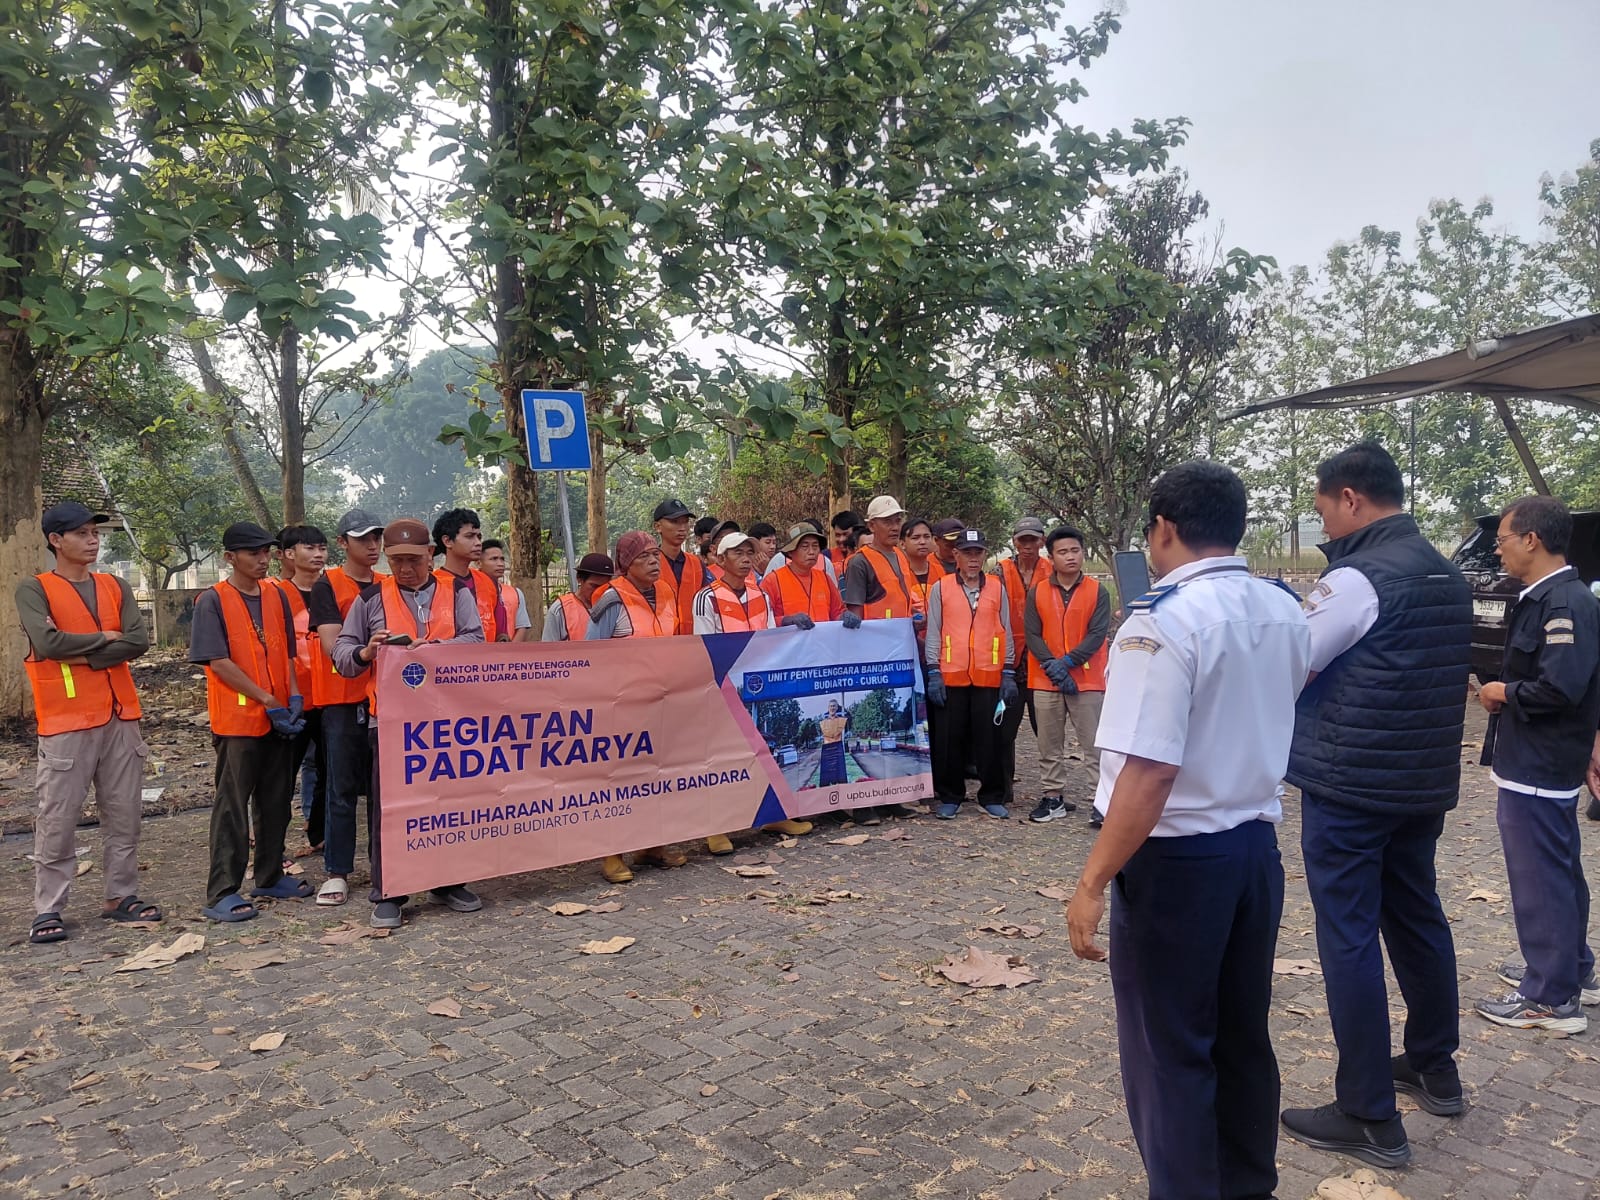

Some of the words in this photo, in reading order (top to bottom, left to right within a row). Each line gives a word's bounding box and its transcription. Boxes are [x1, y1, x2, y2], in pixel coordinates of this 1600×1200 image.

[533, 399, 576, 463] P
[434, 673, 480, 685] BANDAR
[482, 672, 519, 683] UDARA
[520, 669, 571, 681] BUDIARTO
[435, 664, 479, 675] KANTOR
[481, 663, 506, 673] UNIT
[508, 659, 591, 672] PENYELENGGARA
[767, 671, 789, 683] UNIT
[790, 665, 860, 681] PENYELENGGARA
[861, 663, 894, 674] BANDAR
[814, 677, 854, 690] BUDIARTO
[860, 674, 889, 686] CURUG
[403, 708, 593, 751] KEGIATAN
[404, 743, 532, 785] PADAT
[540, 730, 654, 768] KARYA
[406, 797, 553, 835] PEMELIHARAAN
[558, 789, 611, 812] JALAN
[616, 779, 672, 801] MASUK
[677, 768, 751, 792] BANDARA
[407, 827, 467, 852] KANTOR
[470, 821, 510, 841] UPBU
[513, 812, 579, 835] BUDIARTO
[582, 809, 602, 823] T.A
[604, 803, 632, 819] 2026
